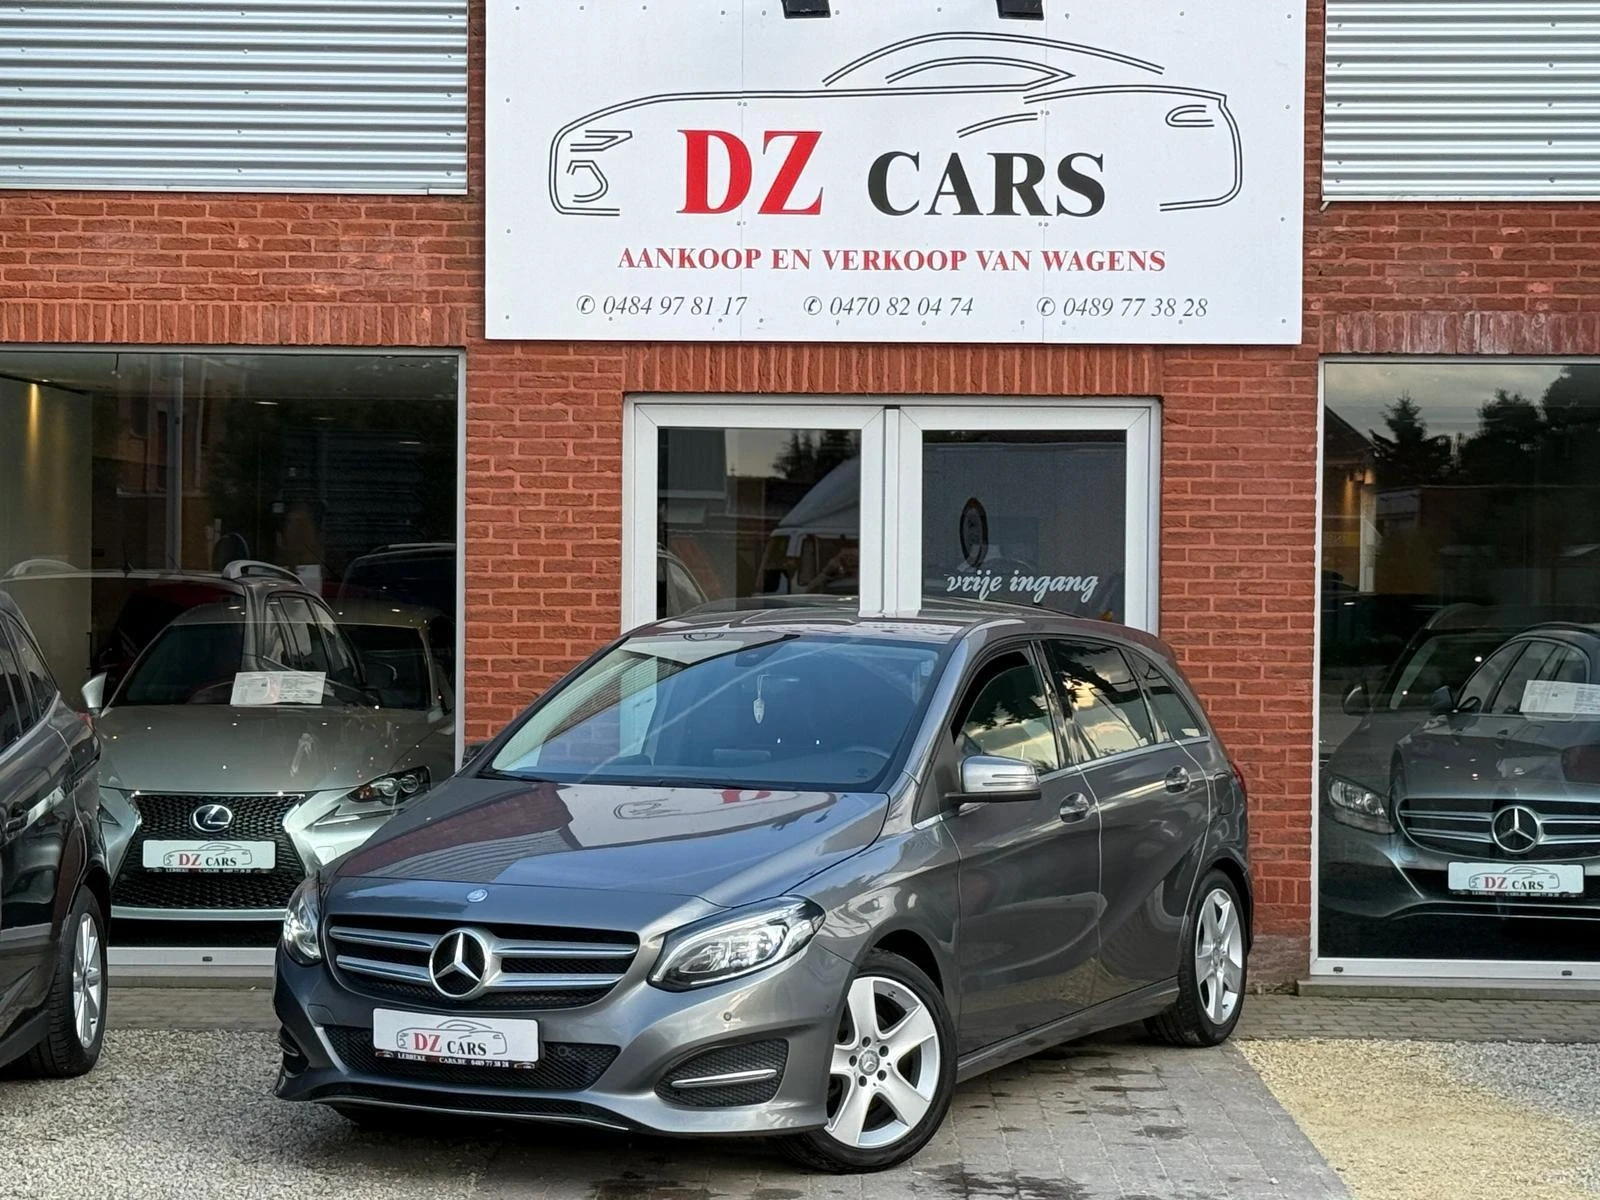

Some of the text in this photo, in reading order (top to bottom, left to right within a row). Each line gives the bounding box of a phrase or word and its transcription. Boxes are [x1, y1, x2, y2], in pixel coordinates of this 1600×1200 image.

[676, 129, 1106, 217] DZ CARS
[617, 247, 1166, 272] AANKOOP EN VERKOOP VAN WAGENS
[602, 295, 748, 317] 0484 97 81 17
[829, 296, 974, 317] 0470 82 04 74
[1063, 296, 1209, 318] 0489 77 38 28
[946, 569, 1099, 604] vrije ingang
[178, 853, 237, 866] DZ CARS
[1484, 876, 1544, 890] DZ CARS
[413, 1032, 487, 1056] DZ CARS
